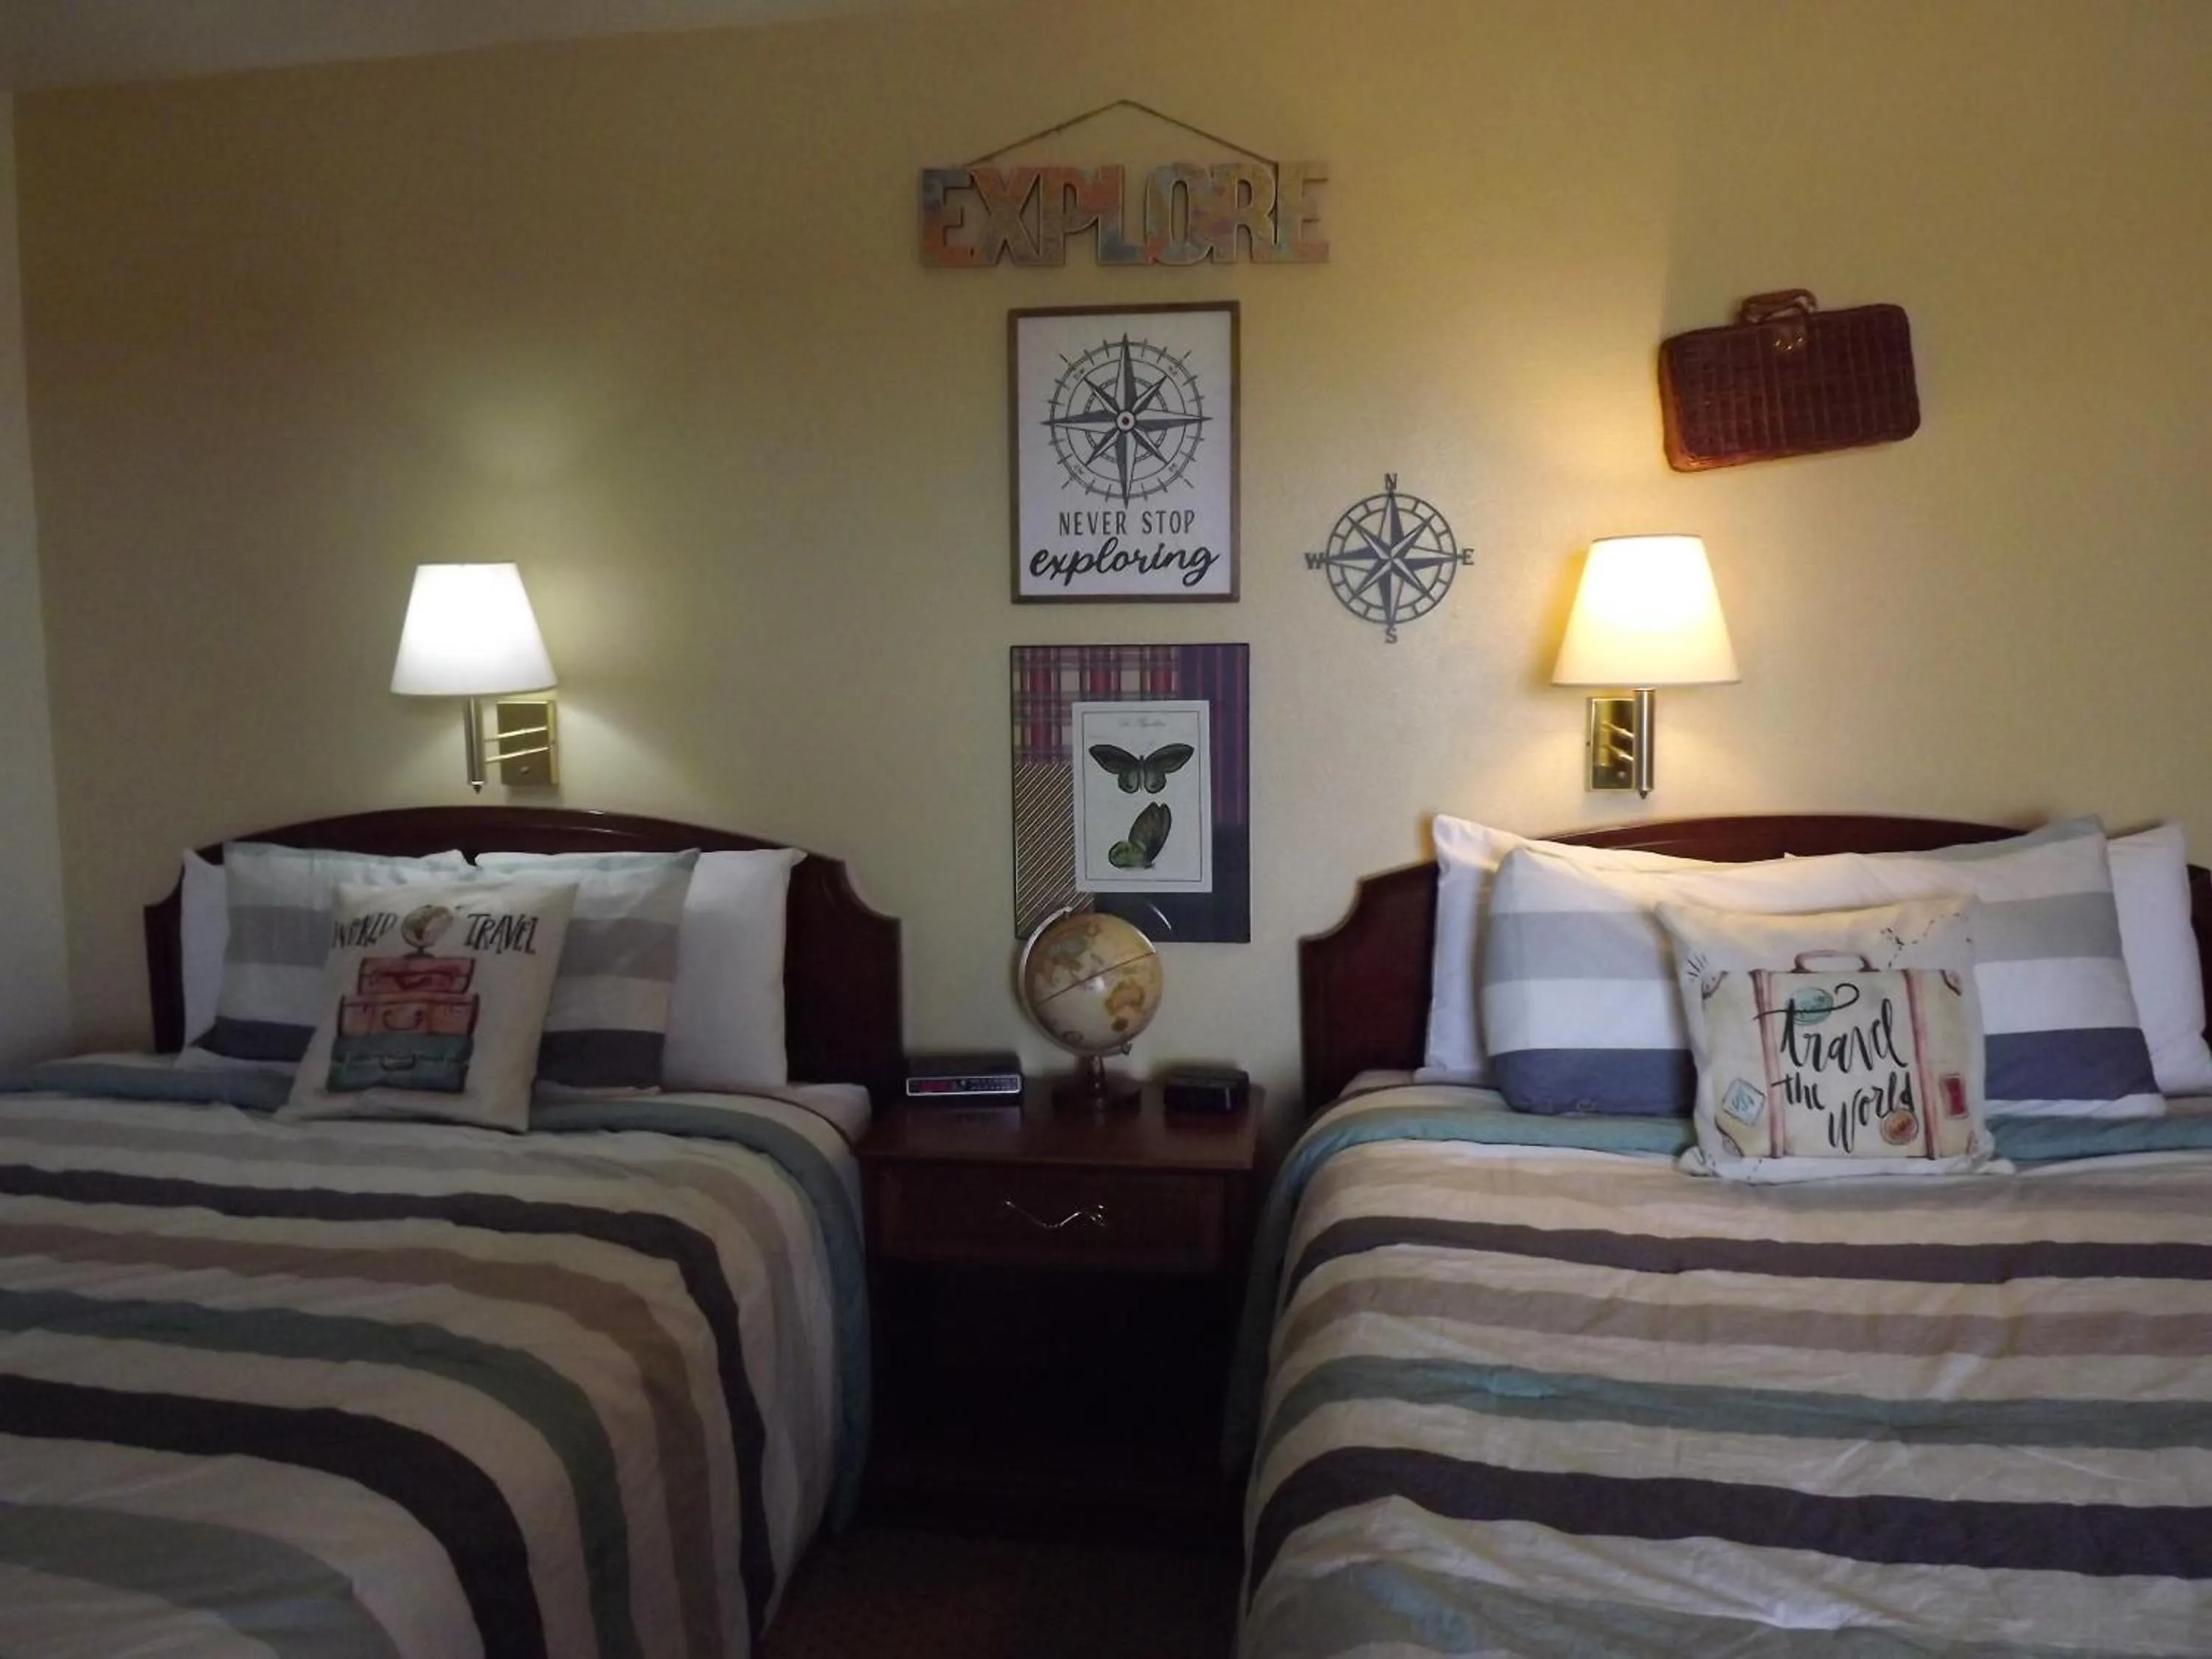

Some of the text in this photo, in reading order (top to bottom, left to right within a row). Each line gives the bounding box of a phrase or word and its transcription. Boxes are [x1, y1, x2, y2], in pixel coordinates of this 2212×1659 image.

[921, 161, 1329, 266] EXPLORE
[1385, 473, 1398, 490] N
[1059, 509, 1195, 536] NEVER STOP
[1030, 536, 1220, 587] exploring
[1304, 552, 1324, 569] W
[1462, 548, 1475, 566] E
[1385, 627, 1398, 644] S
[464, 913, 539, 955] TRAVEL
[1771, 1072, 1825, 1110] the
